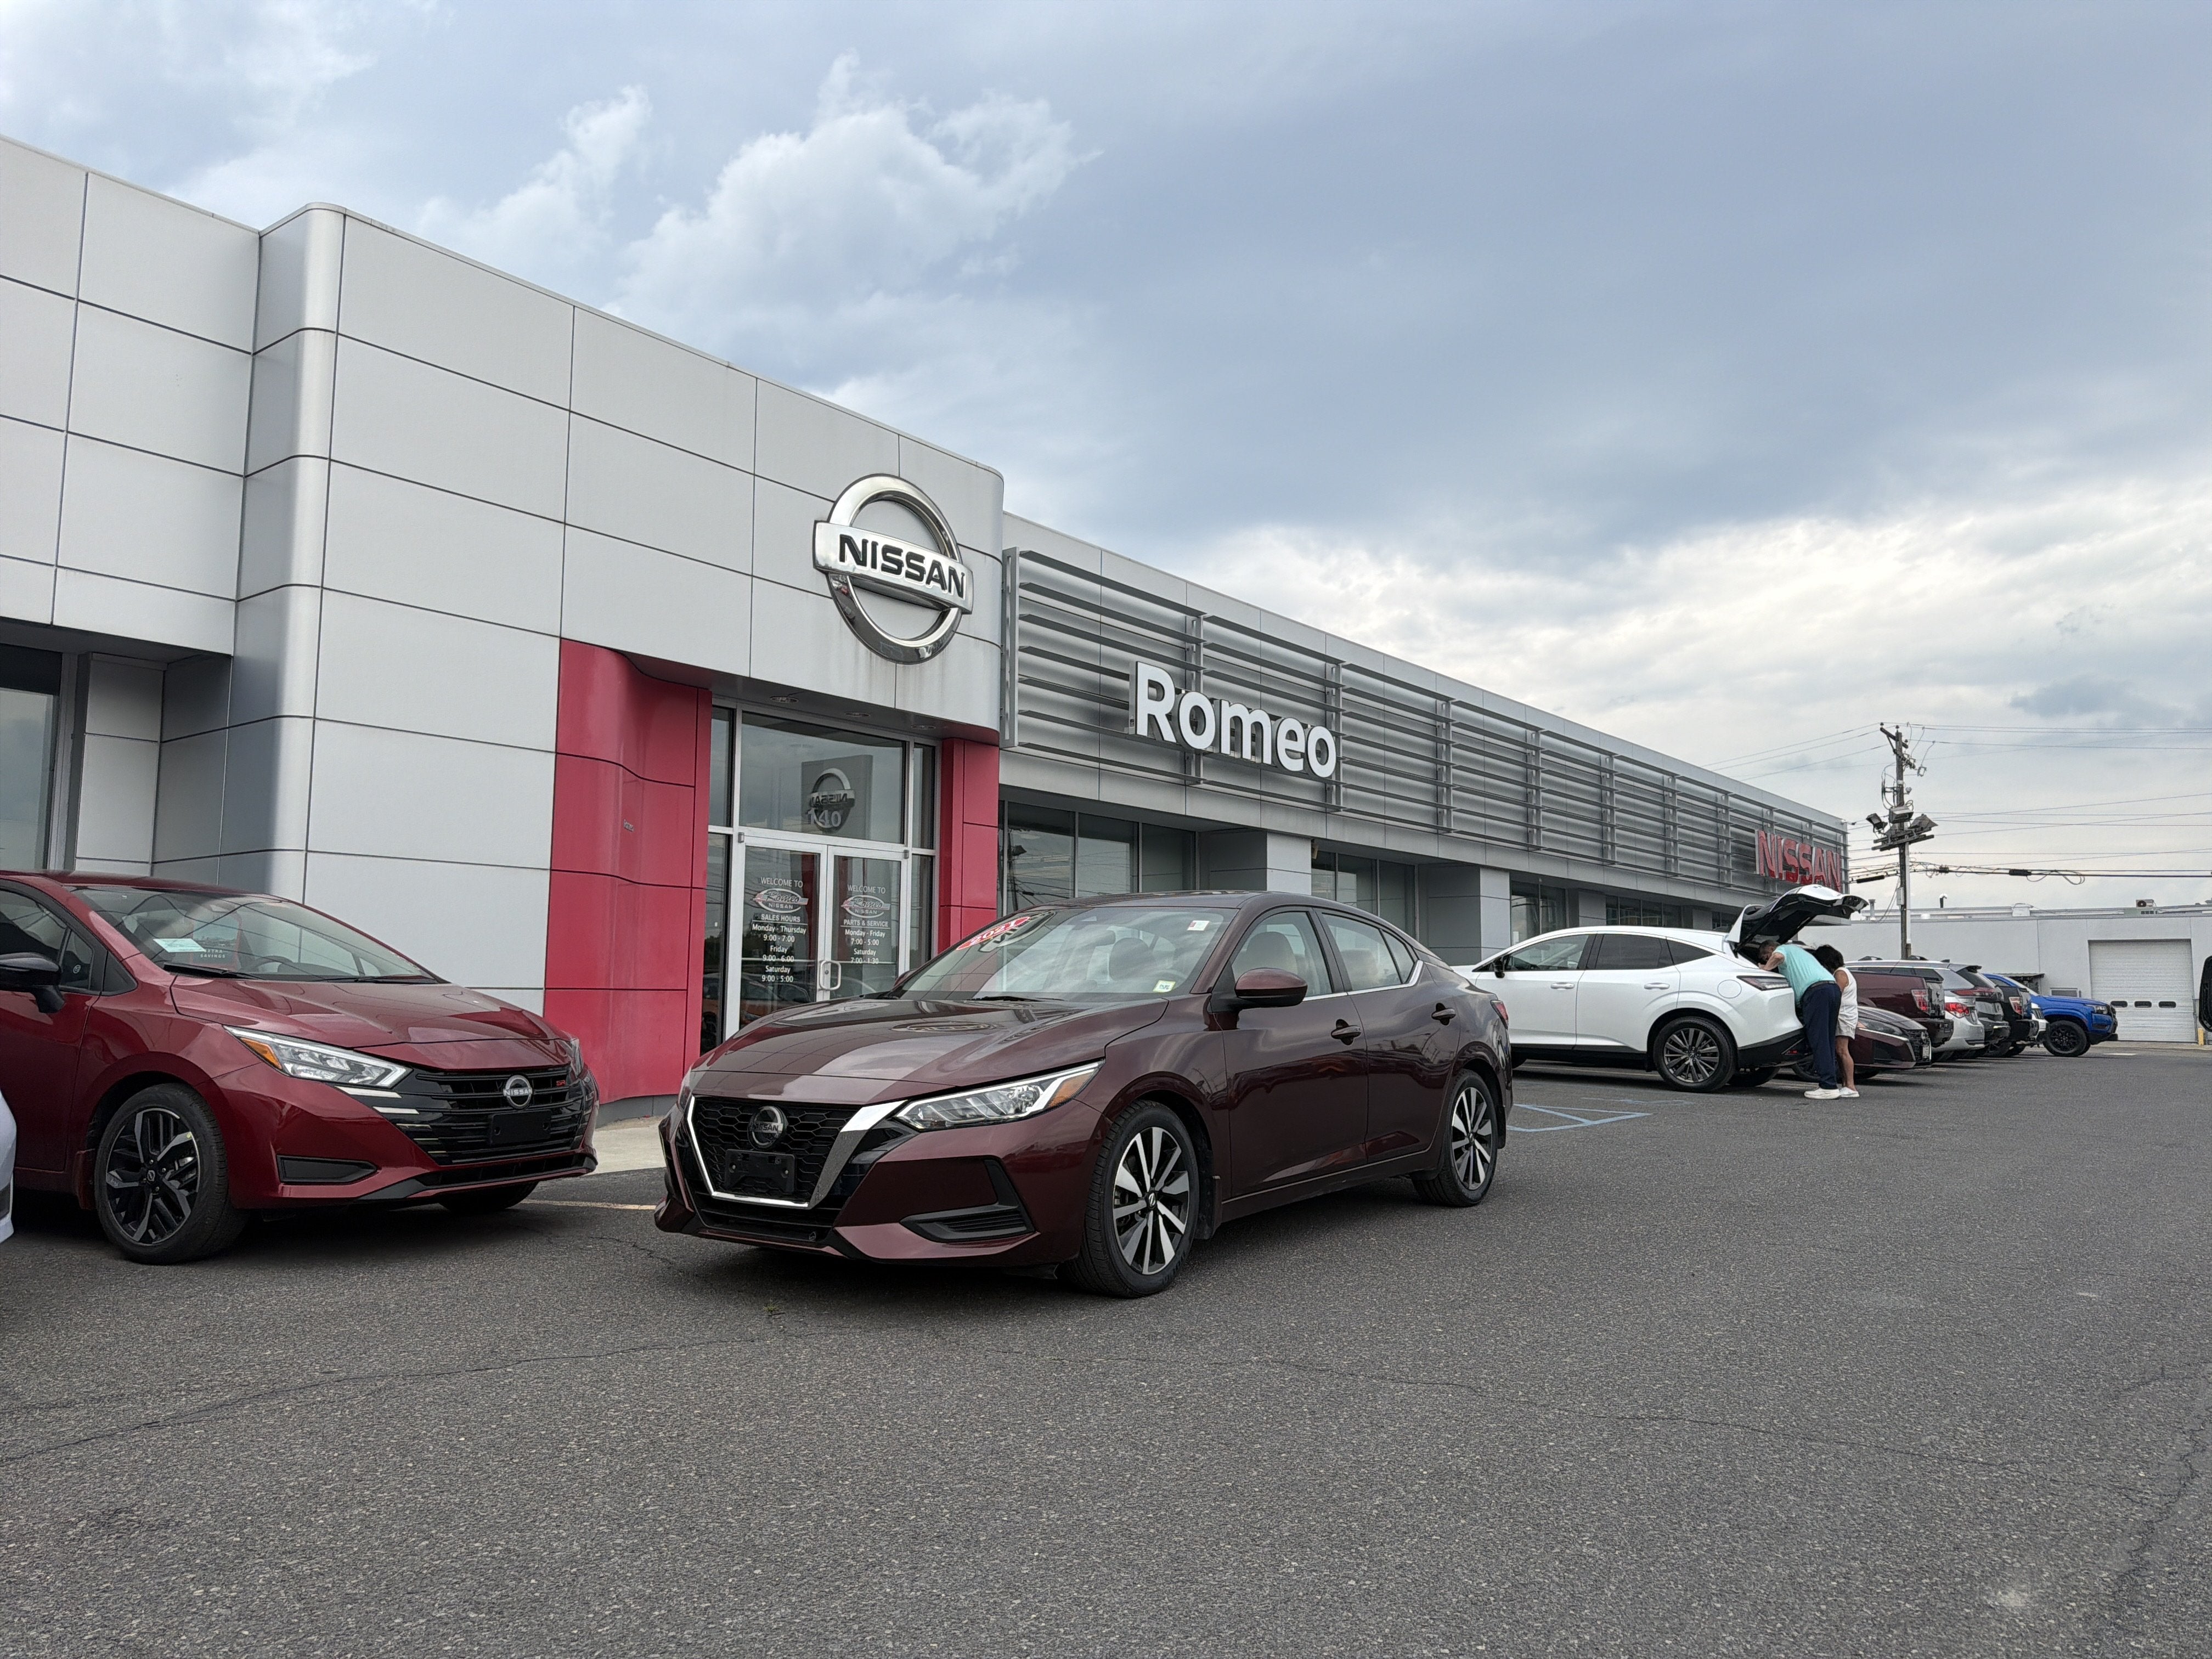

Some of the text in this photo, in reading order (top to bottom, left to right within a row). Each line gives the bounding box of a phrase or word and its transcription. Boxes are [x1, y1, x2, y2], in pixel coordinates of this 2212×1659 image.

[839, 533, 966, 599] NISSAN
[1135, 661, 1336, 778] Romeo
[808, 808, 842, 827] 140
[1757, 830, 1842, 894] NISSAN
[761, 877, 792, 887] WELCOME
[848, 884, 876, 893] WELCOME
[764, 889, 800, 902] Romeo
[850, 896, 883, 909] Romeo
[752, 923, 775, 933] Monday
[780, 926, 806, 934] Thursday
[845, 928, 866, 937] Monday
[870, 930, 885, 938] Friday
[970, 919, 1017, 945] 2021
[770, 945, 788, 953] Friday
[854, 948, 876, 956] Saturday
[765, 965, 791, 974] Saturday
